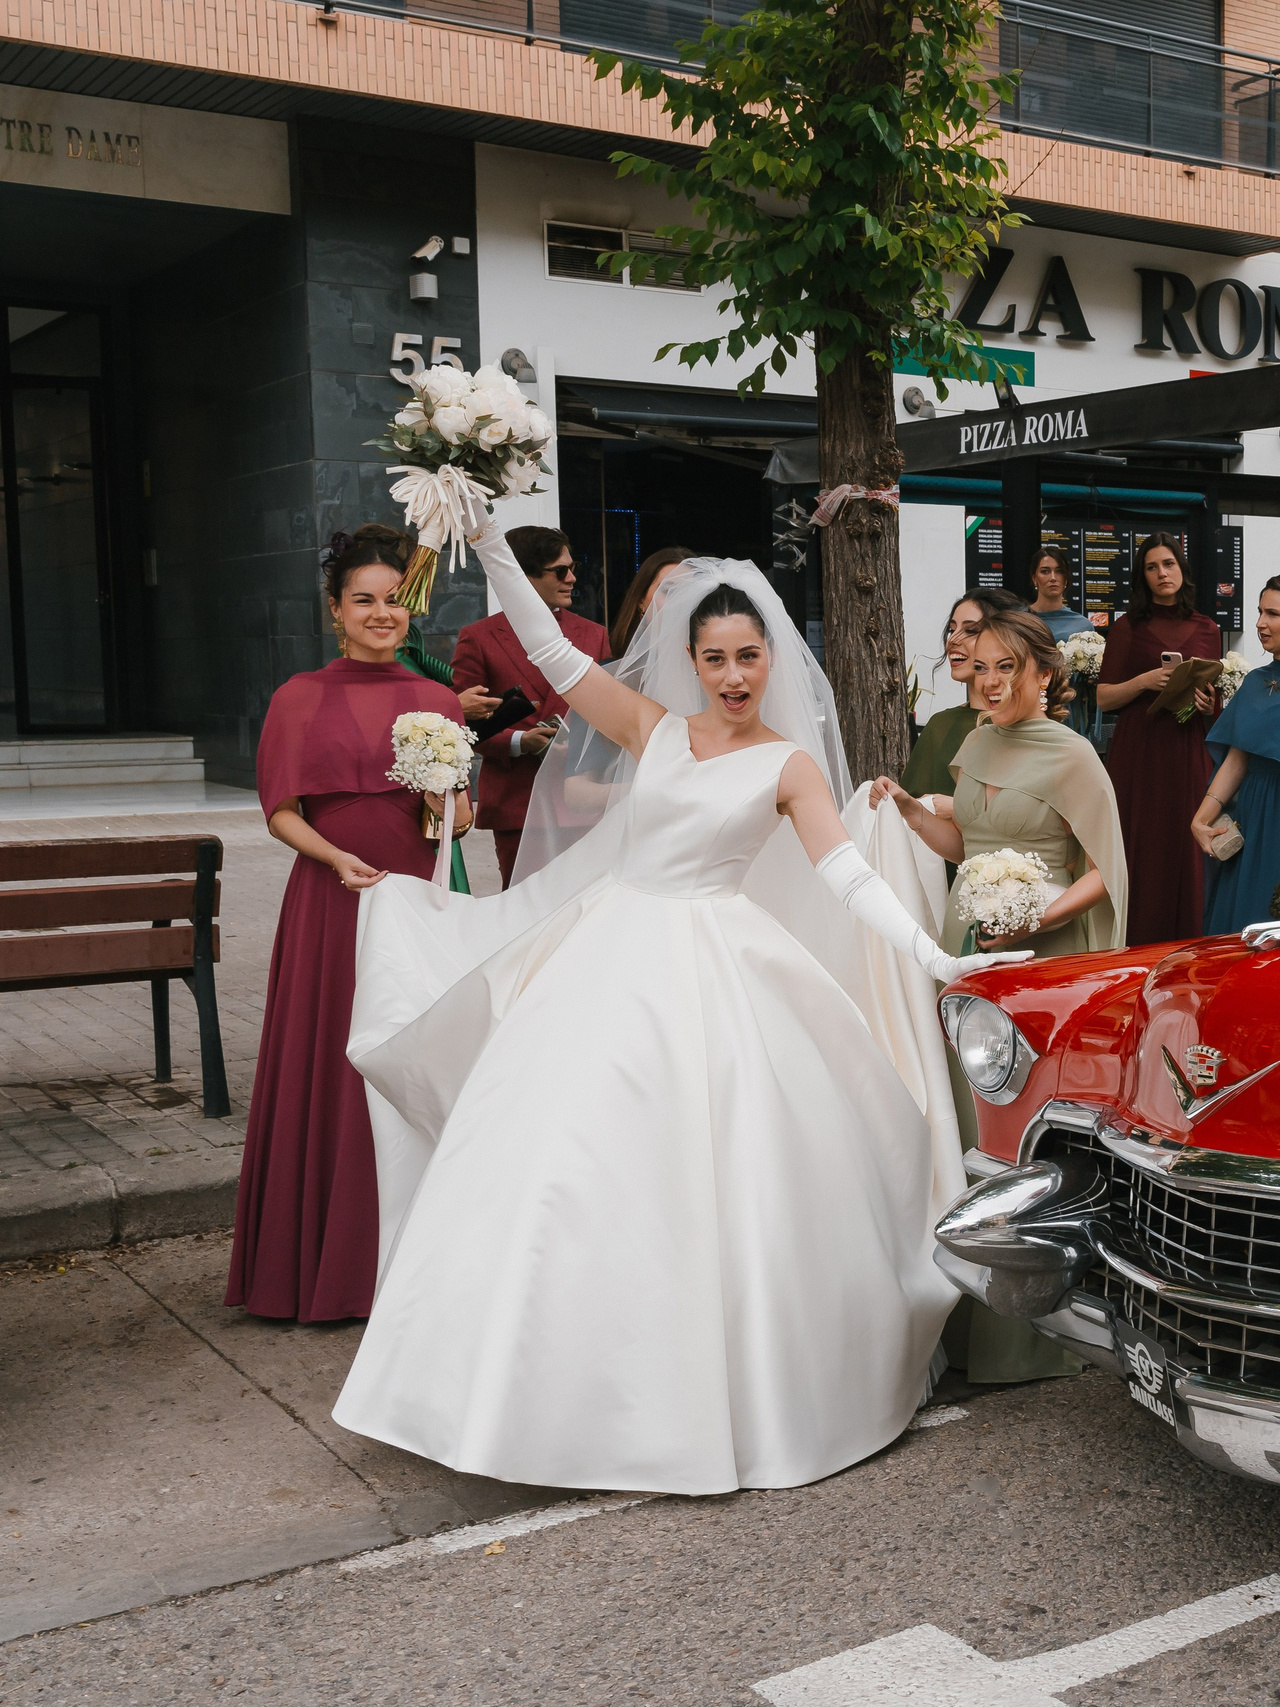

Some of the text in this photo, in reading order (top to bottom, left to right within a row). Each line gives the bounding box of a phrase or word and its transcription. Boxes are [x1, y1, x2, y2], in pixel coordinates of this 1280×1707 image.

[65, 126, 141, 166] DAME
[389, 333, 465, 385] 55
[959, 408, 1089, 454] PIZZA ROMA
